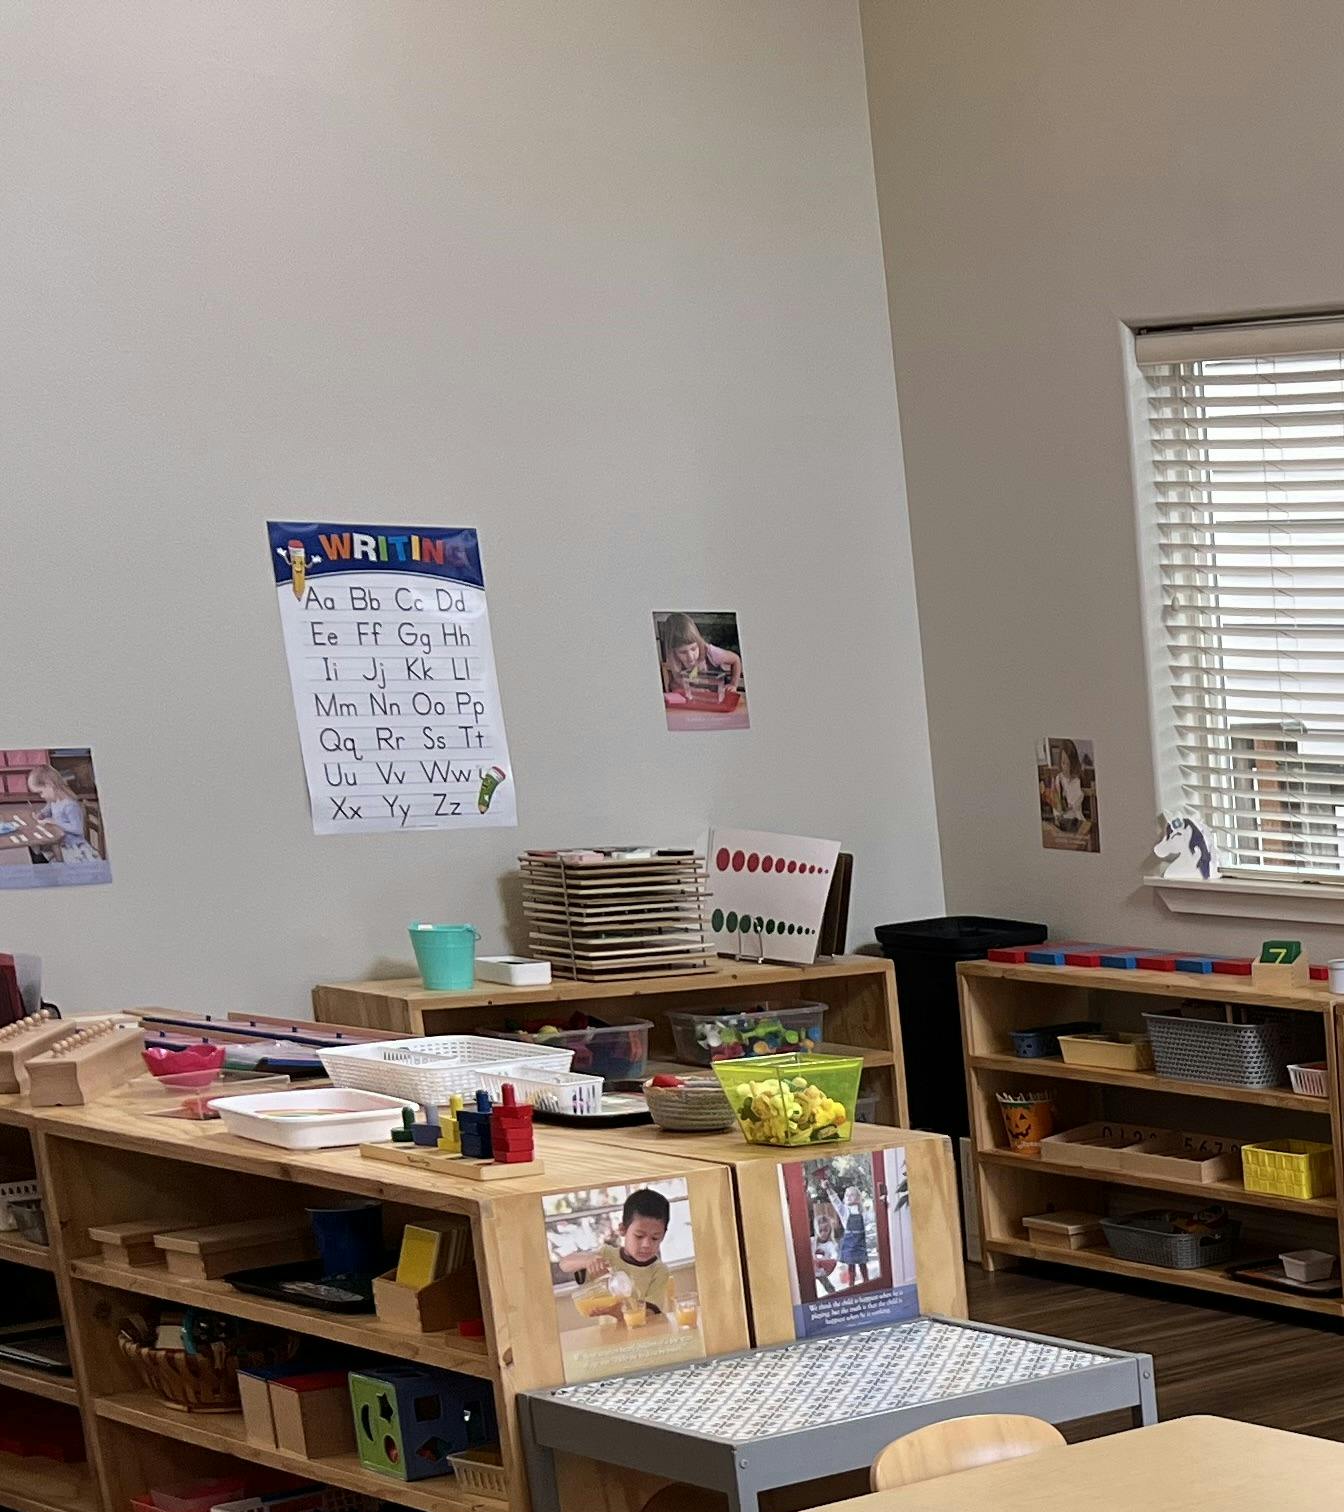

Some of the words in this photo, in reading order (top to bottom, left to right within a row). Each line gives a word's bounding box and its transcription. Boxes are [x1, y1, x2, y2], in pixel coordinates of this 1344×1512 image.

[305, 586, 336, 611] Aa
[349, 586, 381, 611] Bb
[395, 587, 424, 611] Cc
[435, 588, 466, 612] Dd
[311, 621, 338, 646] Ee
[357, 622, 383, 646] Ff
[398, 622, 431, 655] Gg
[442, 623, 470, 646] Hh
[322, 657, 339, 681] Ii
[362, 657, 386, 690] Jj
[405, 657, 434, 681] Kk
[451, 657, 471, 681] Ll
[314, 692, 358, 717] Mm
[370, 692, 401, 716] Nn
[412, 692, 446, 716] Oo
[456, 692, 485, 724] Pp
[320, 728, 364, 761] Qq
[376, 728, 406, 750] Rr
[422, 726, 447, 750] Ss
[458, 726, 485, 749] Tt
[323, 762, 358, 787] Uu
[376, 761, 406, 785] Vv
[419, 760, 472, 784] Ww
[330, 796, 363, 820] Xx
[382, 795, 411, 828] Yy
[433, 793, 463, 817] Zz
[1269, 948, 1287, 964] 7
